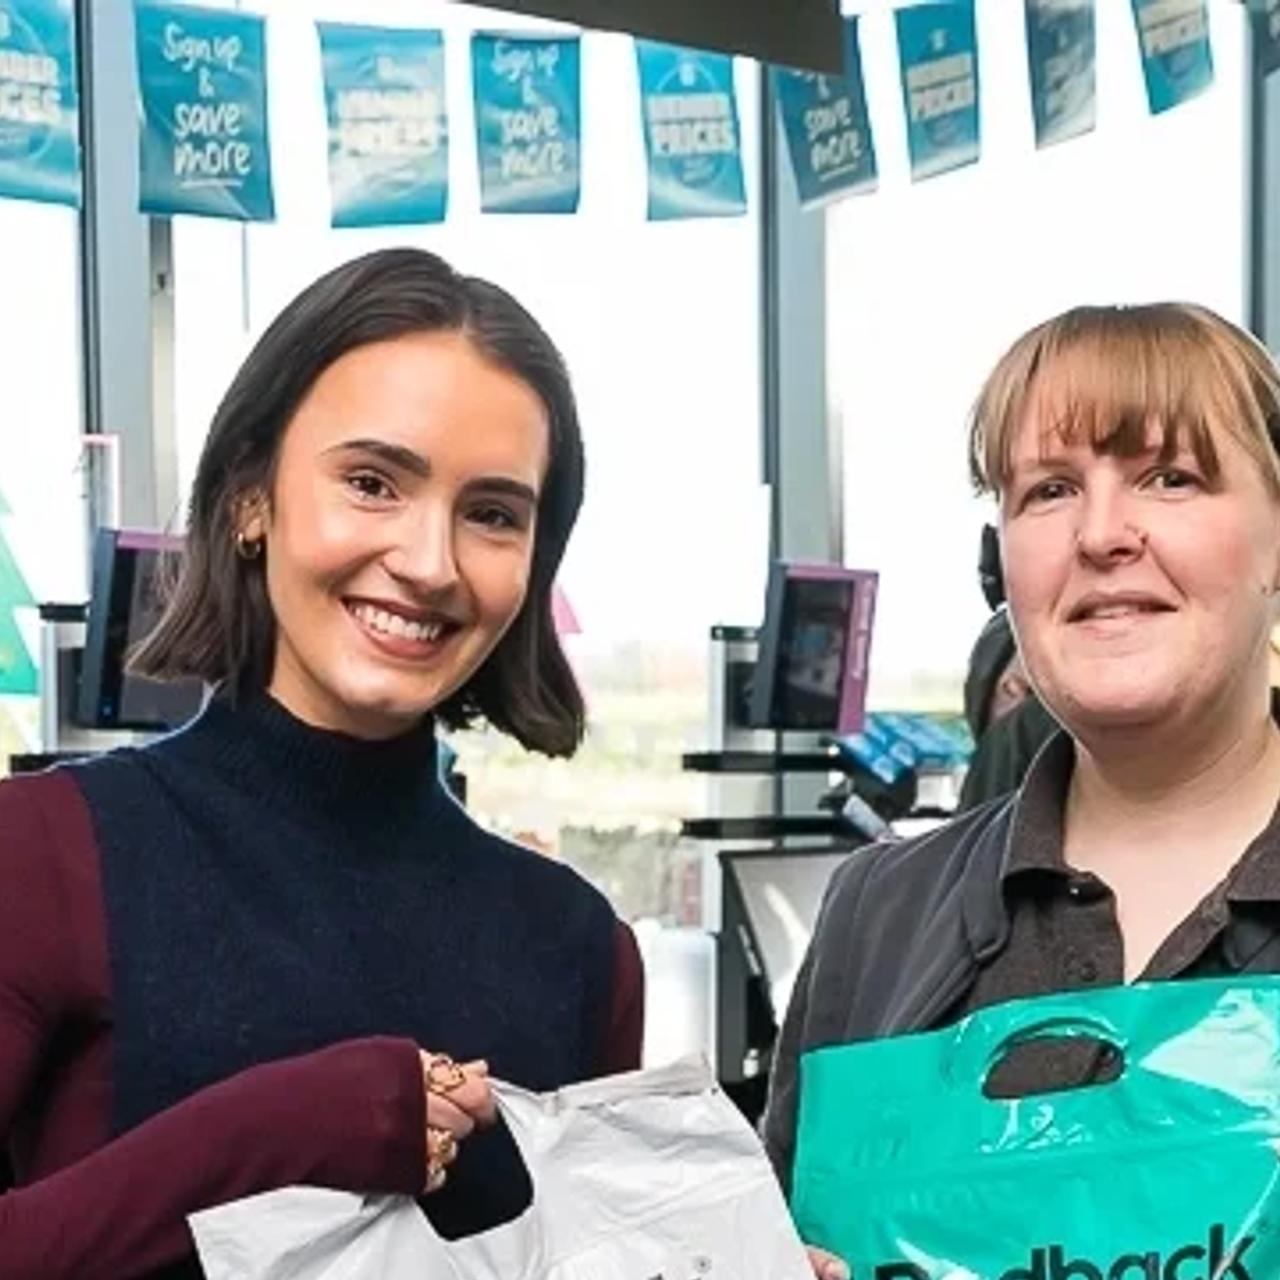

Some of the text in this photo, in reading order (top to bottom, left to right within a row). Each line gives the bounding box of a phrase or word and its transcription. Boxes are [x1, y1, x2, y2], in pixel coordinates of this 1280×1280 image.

[163, 22, 243, 73] Sign up
[174, 103, 241, 137] save
[174, 141, 251, 175] more
